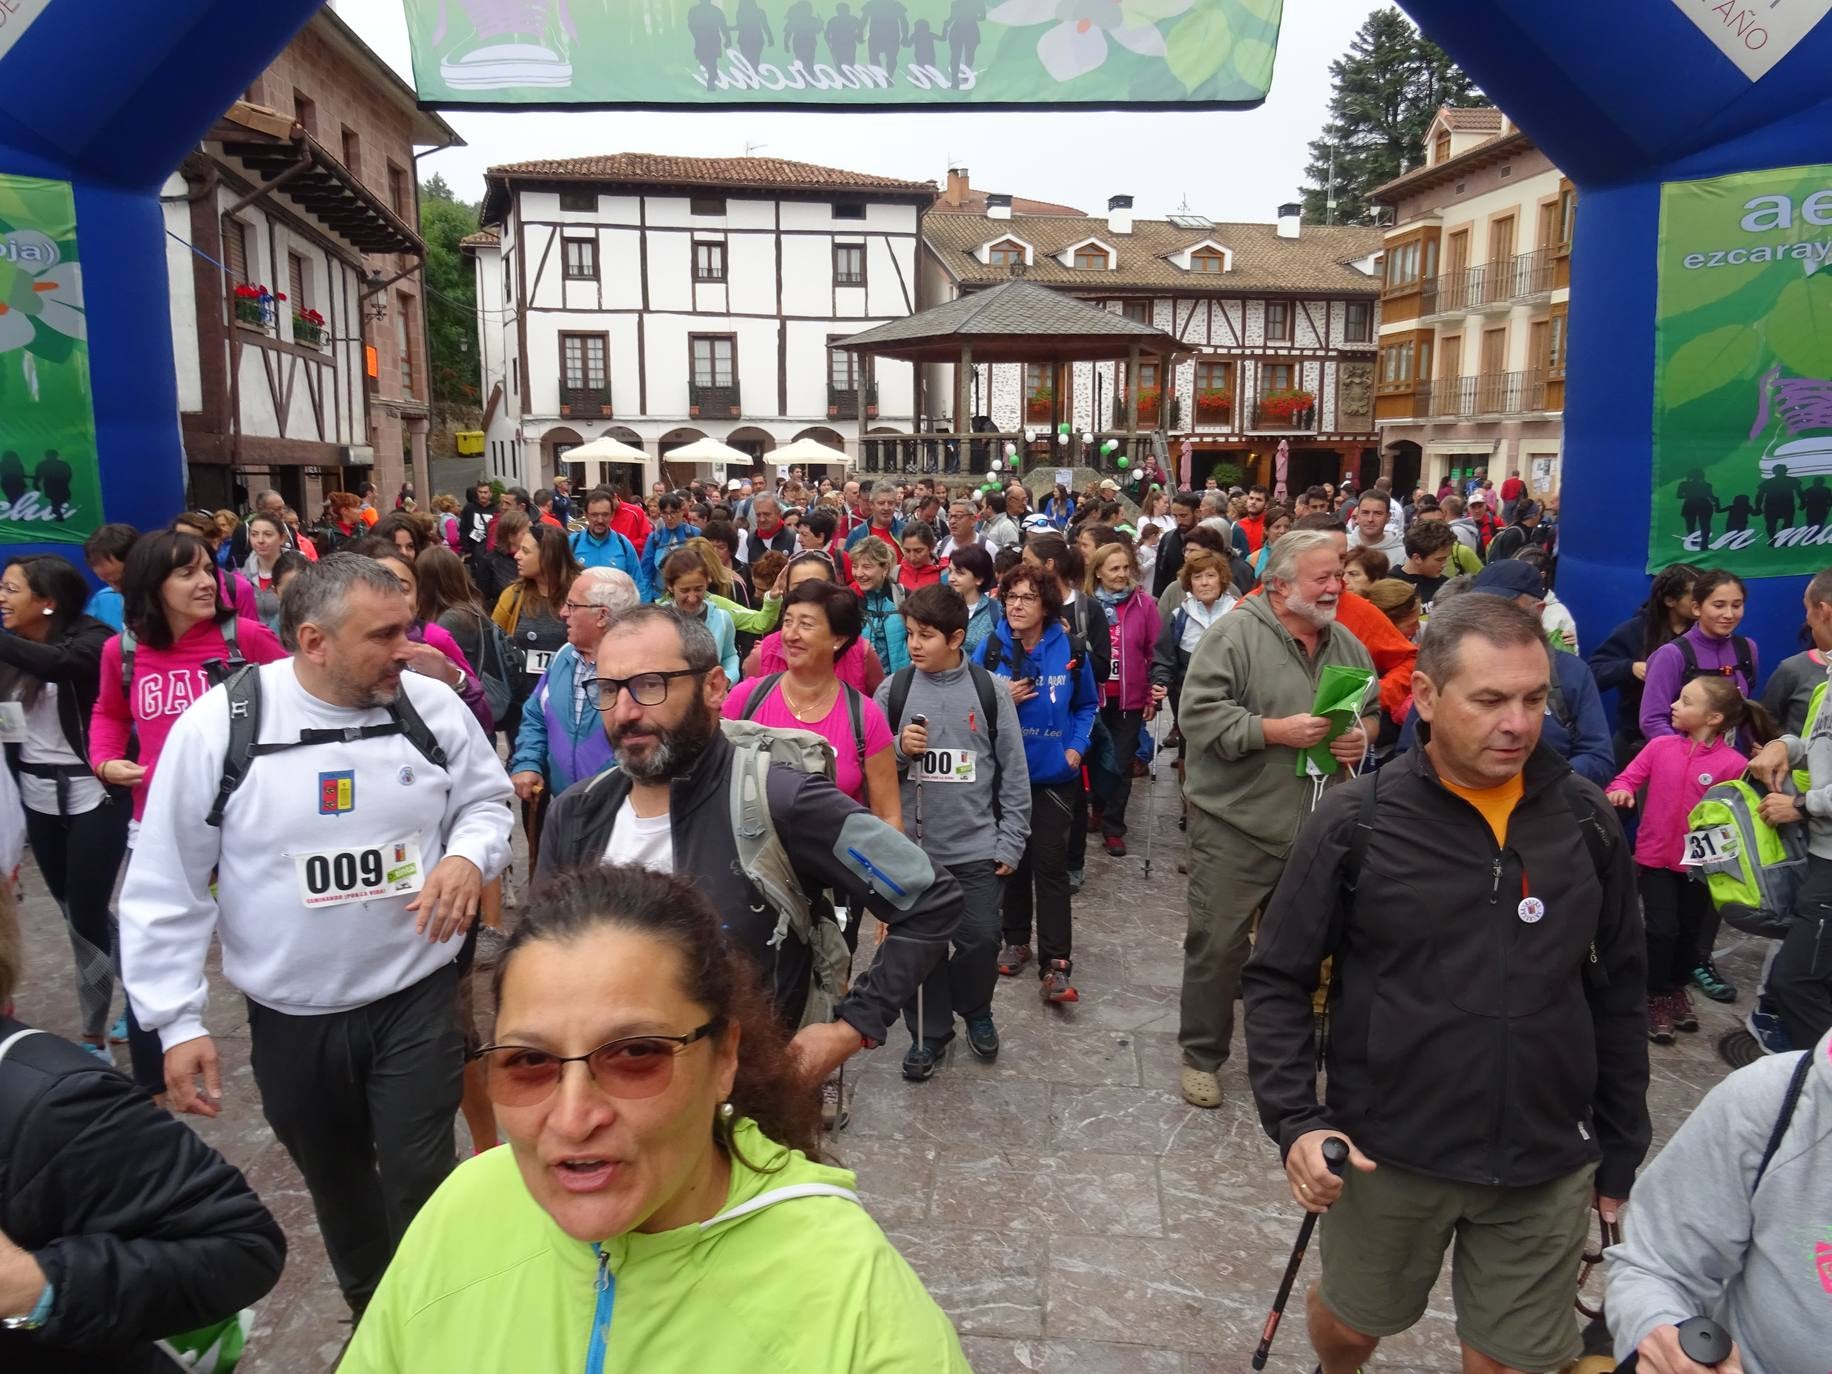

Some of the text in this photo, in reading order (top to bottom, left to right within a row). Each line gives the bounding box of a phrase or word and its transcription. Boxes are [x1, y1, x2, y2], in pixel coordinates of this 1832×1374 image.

[1711, 0, 1768, 50] AÑO
[1672, 528, 1763, 551] en
[920, 750, 952, 774] 00
[306, 849, 383, 894] 009
